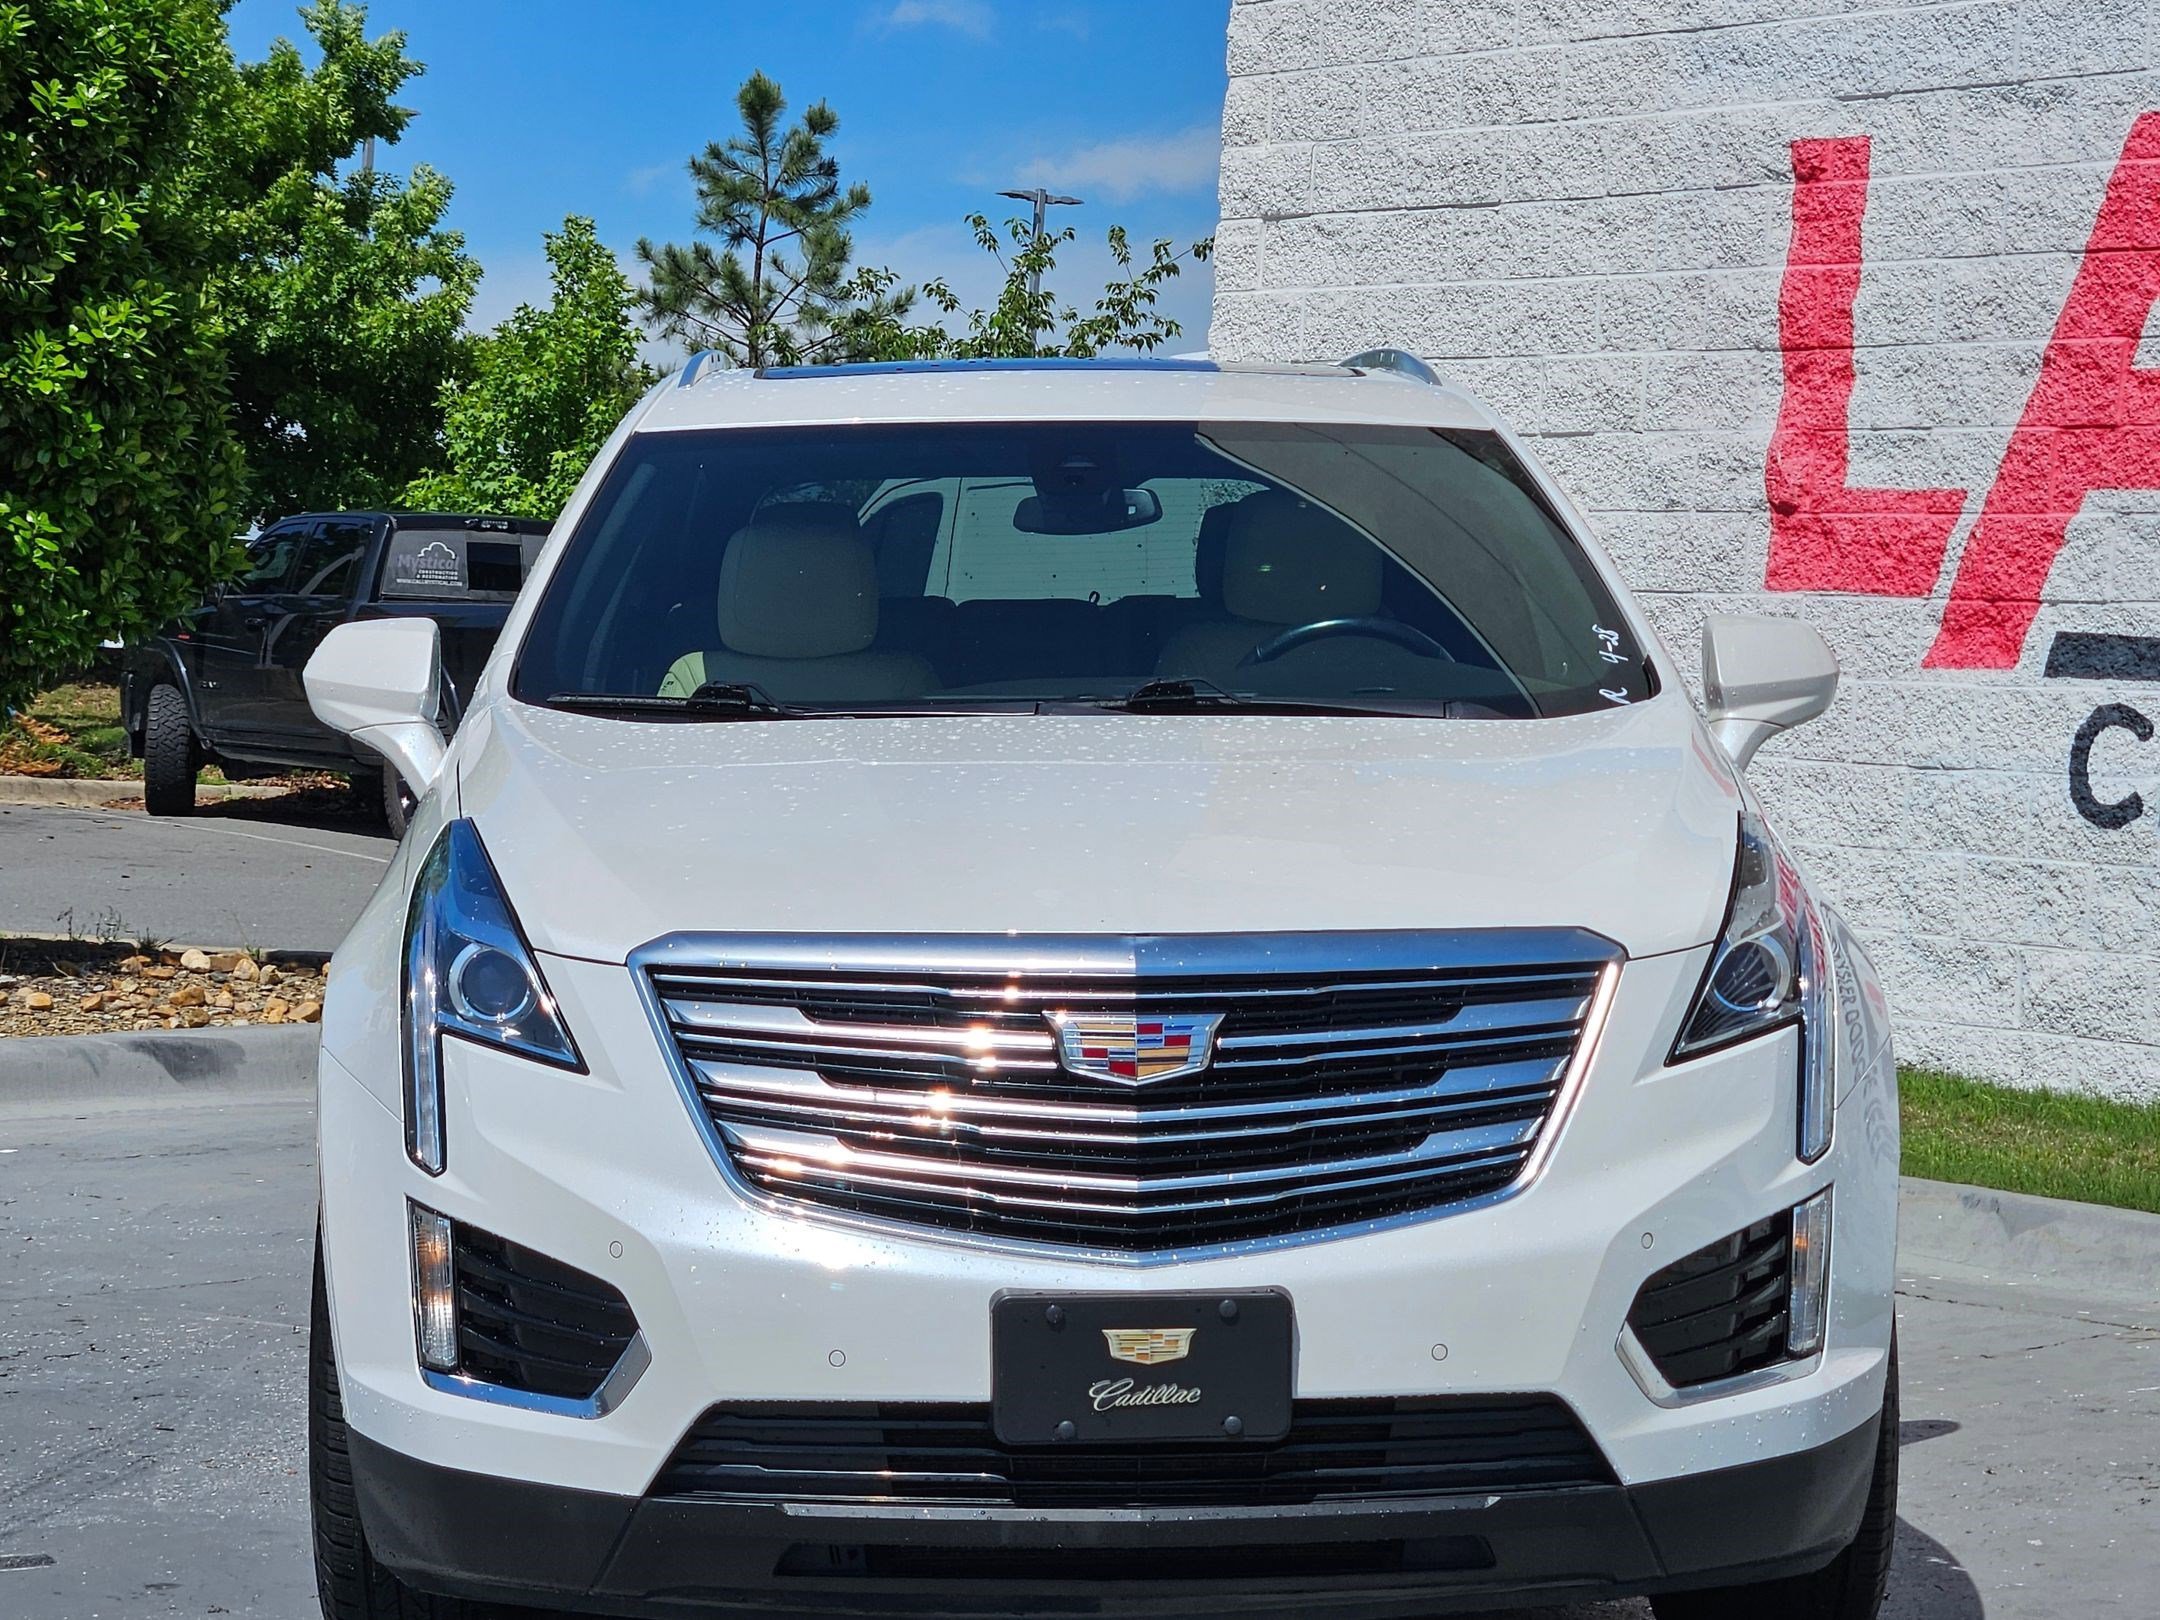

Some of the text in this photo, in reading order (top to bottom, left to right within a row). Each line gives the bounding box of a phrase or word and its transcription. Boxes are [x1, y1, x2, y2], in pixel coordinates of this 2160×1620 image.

[397, 553, 460, 576] Mystical
[2069, 703, 2154, 829] C
[1088, 1377, 1201, 1412] Cadillac
